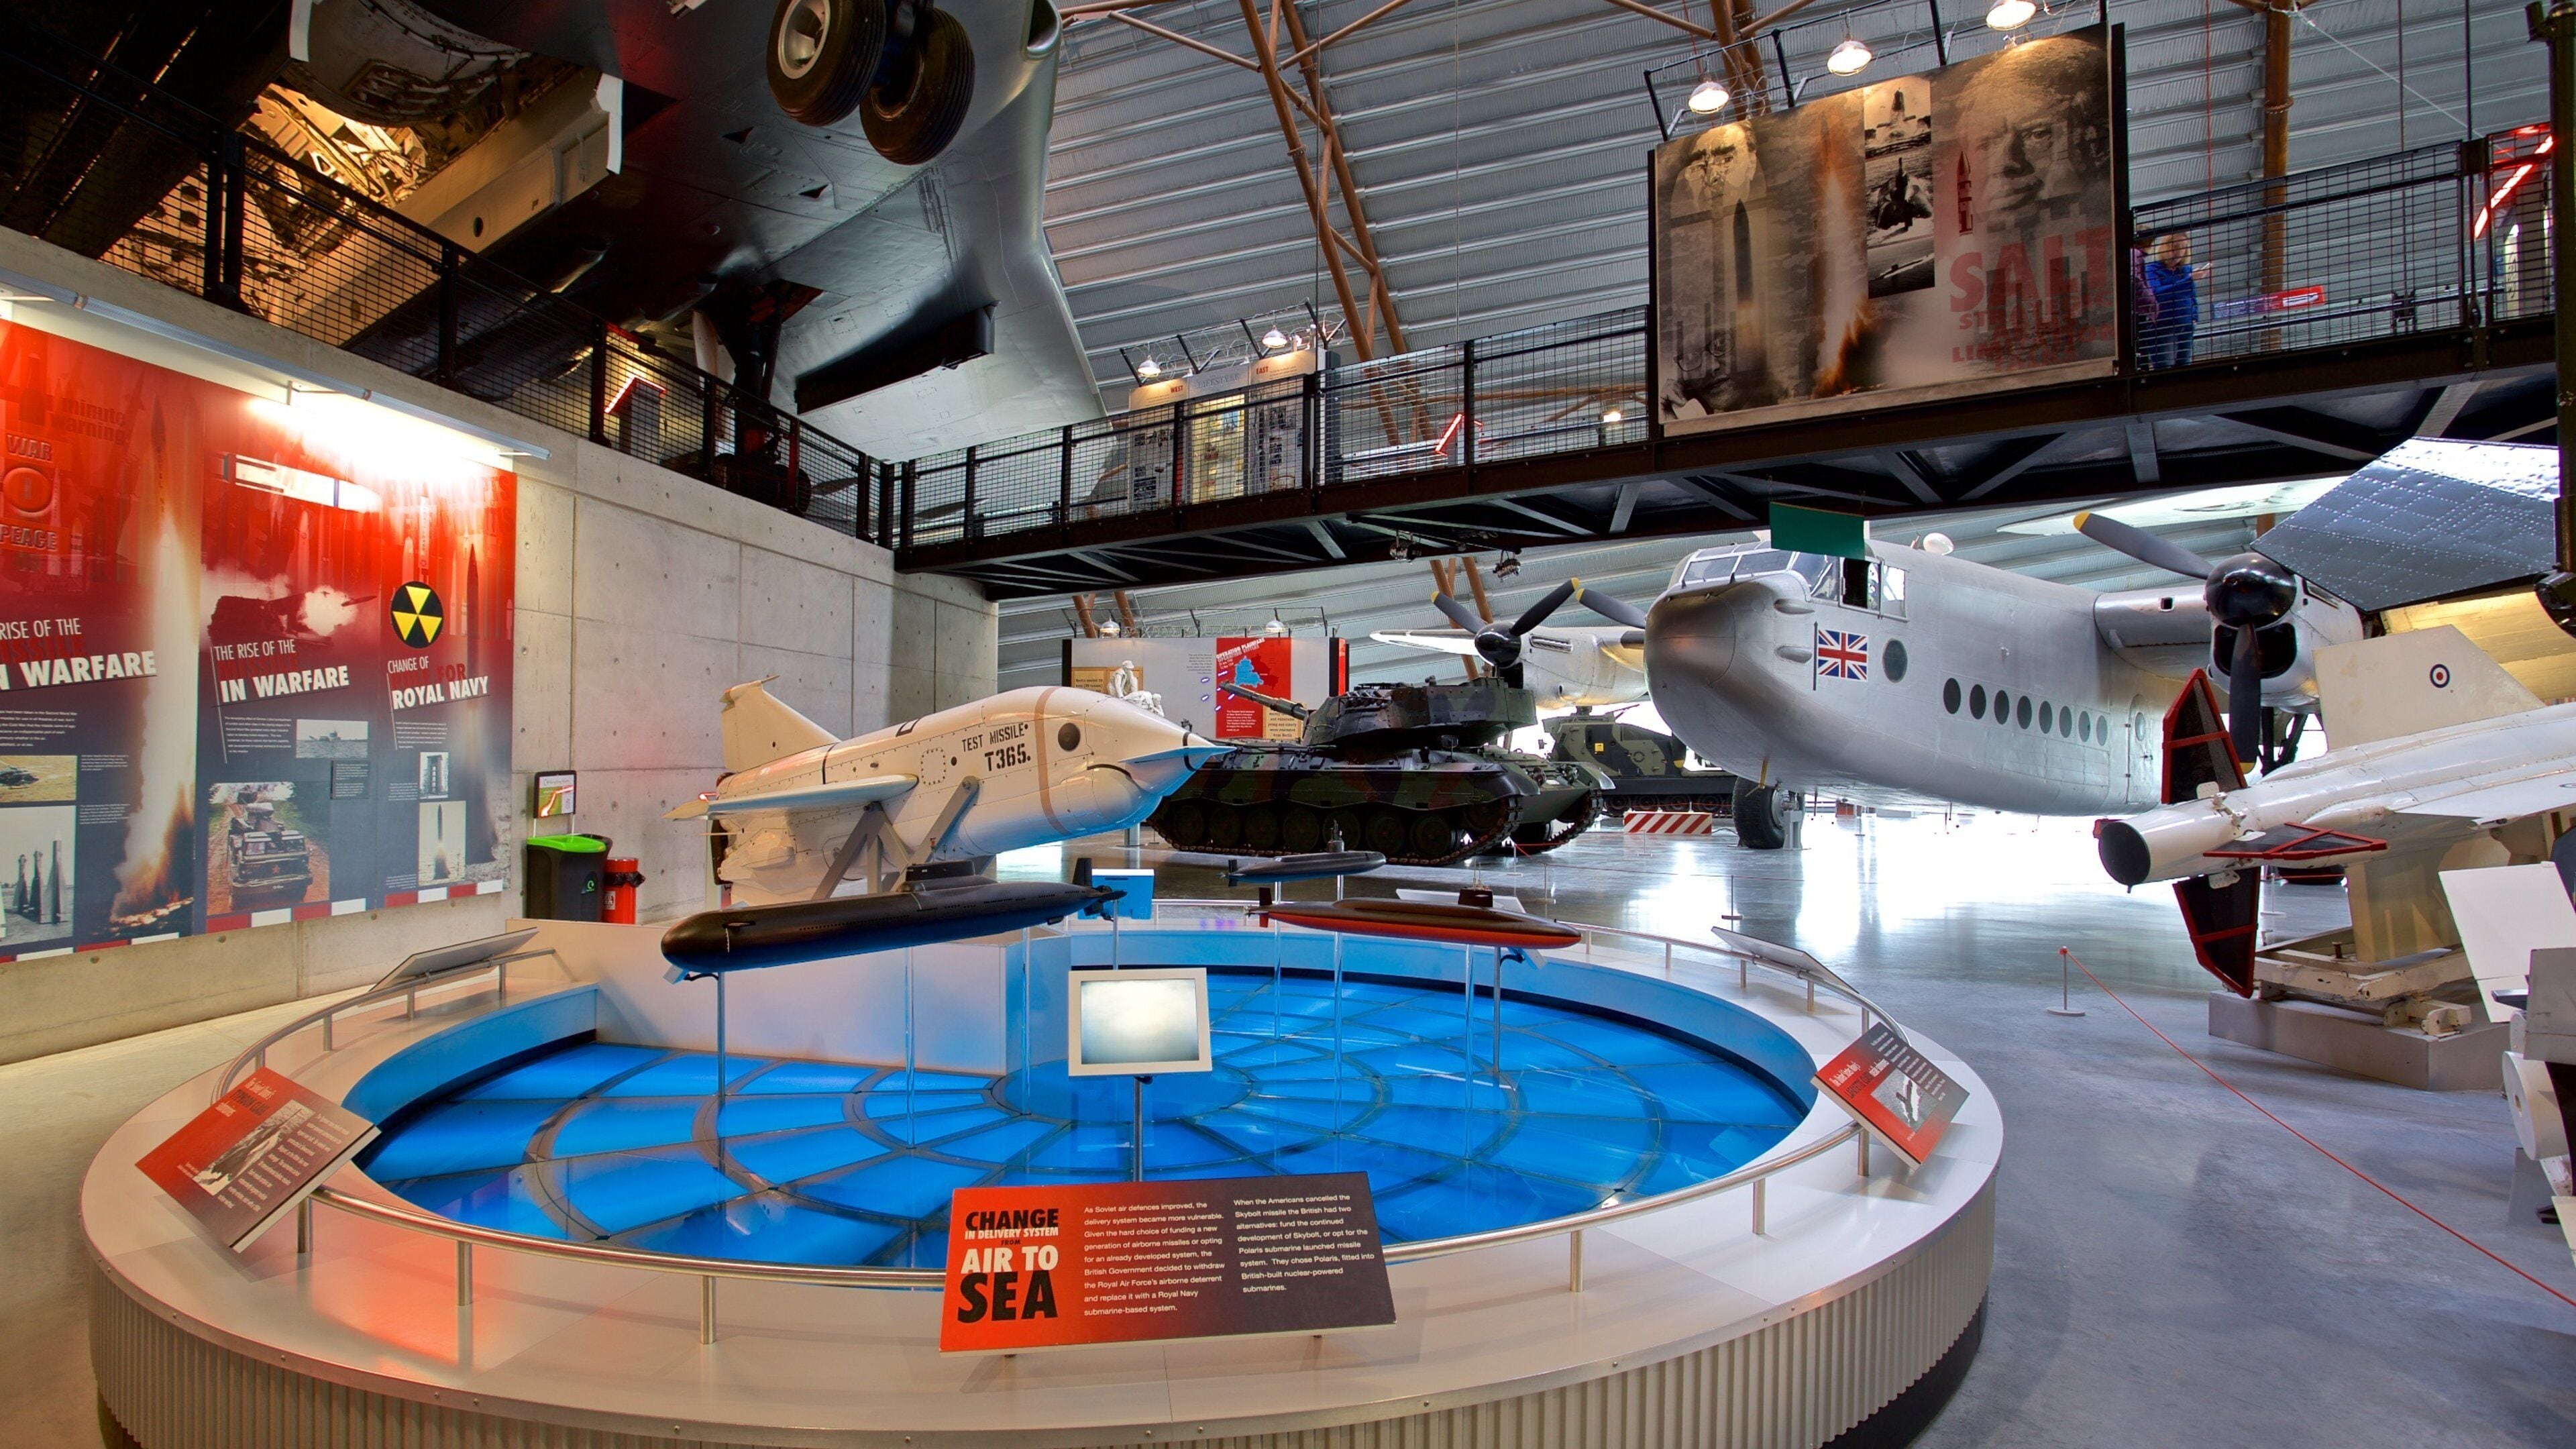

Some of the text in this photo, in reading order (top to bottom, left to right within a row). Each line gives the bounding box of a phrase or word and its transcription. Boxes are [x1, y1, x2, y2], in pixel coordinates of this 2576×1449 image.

[1949, 225, 2112, 323] SALT
[1256, 366, 1269, 375] EAST
[1170, 385, 1183, 394] WEST
[6, 433, 54, 463] WAR
[0, 524, 57, 551] PEACE
[0, 618, 82, 640] RISE OF THE
[215, 639, 296, 661] THE RISE OF THE
[19, 651, 157, 687] WARFARE
[388, 656, 429, 673] CHANGE OF
[437, 663, 467, 682] FOR
[220, 665, 350, 702] IN WARFARE
[392, 676, 488, 709] ROYAL NAVY
[962, 723, 1025, 752] TEST MISSILE
[965, 1208, 1059, 1231] CHANGE
[1113, 1216, 1137, 1224] system
[1235, 1210, 1261, 1218] Skybolt
[965, 1227, 1059, 1240] IN DELIVERY SYSTEM
[1238, 1234, 1283, 1242] development
[1084, 1243, 1121, 1251] generation
[1265, 1244, 1301, 1253] submarine
[961, 1245, 1059, 1274] AIR TO
[1240, 1260, 1268, 1268] system.
[1271, 1258, 1289, 1266] They
[1085, 1268, 1107, 1276] British
[1108, 1267, 1152, 1275] Government
[1242, 1268, 1344, 1280] British-built nuclear-powered
[1190, 1275, 1222, 1283] deterrent
[1243, 1285, 1287, 1293] submarines.
[957, 1270, 1058, 1323] SEA
[1100, 1294, 1126, 1302] replace
[1158, 1291, 1178, 1299] Royal
[1084, 1304, 1177, 1316] submarine-based system.
